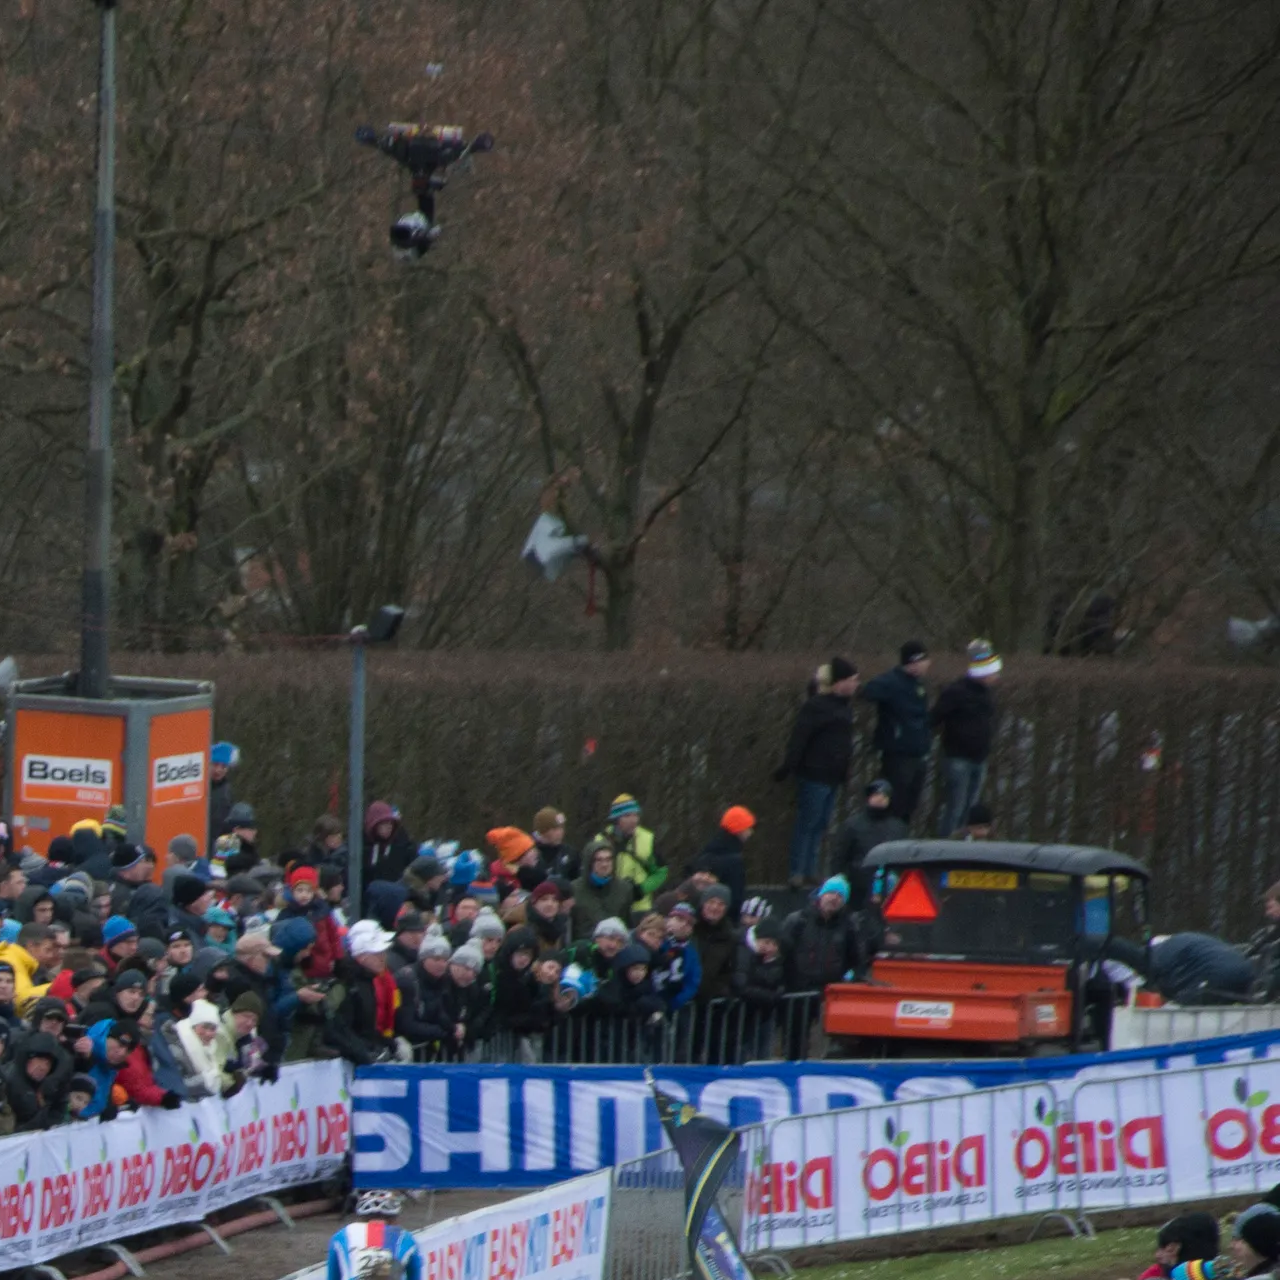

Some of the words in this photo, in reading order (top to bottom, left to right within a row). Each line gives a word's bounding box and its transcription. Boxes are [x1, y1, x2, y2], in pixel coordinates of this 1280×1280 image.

[27, 760, 107, 785] Boels
[156, 759, 202, 783] Boels
[352, 1075, 977, 1174] SHIM
